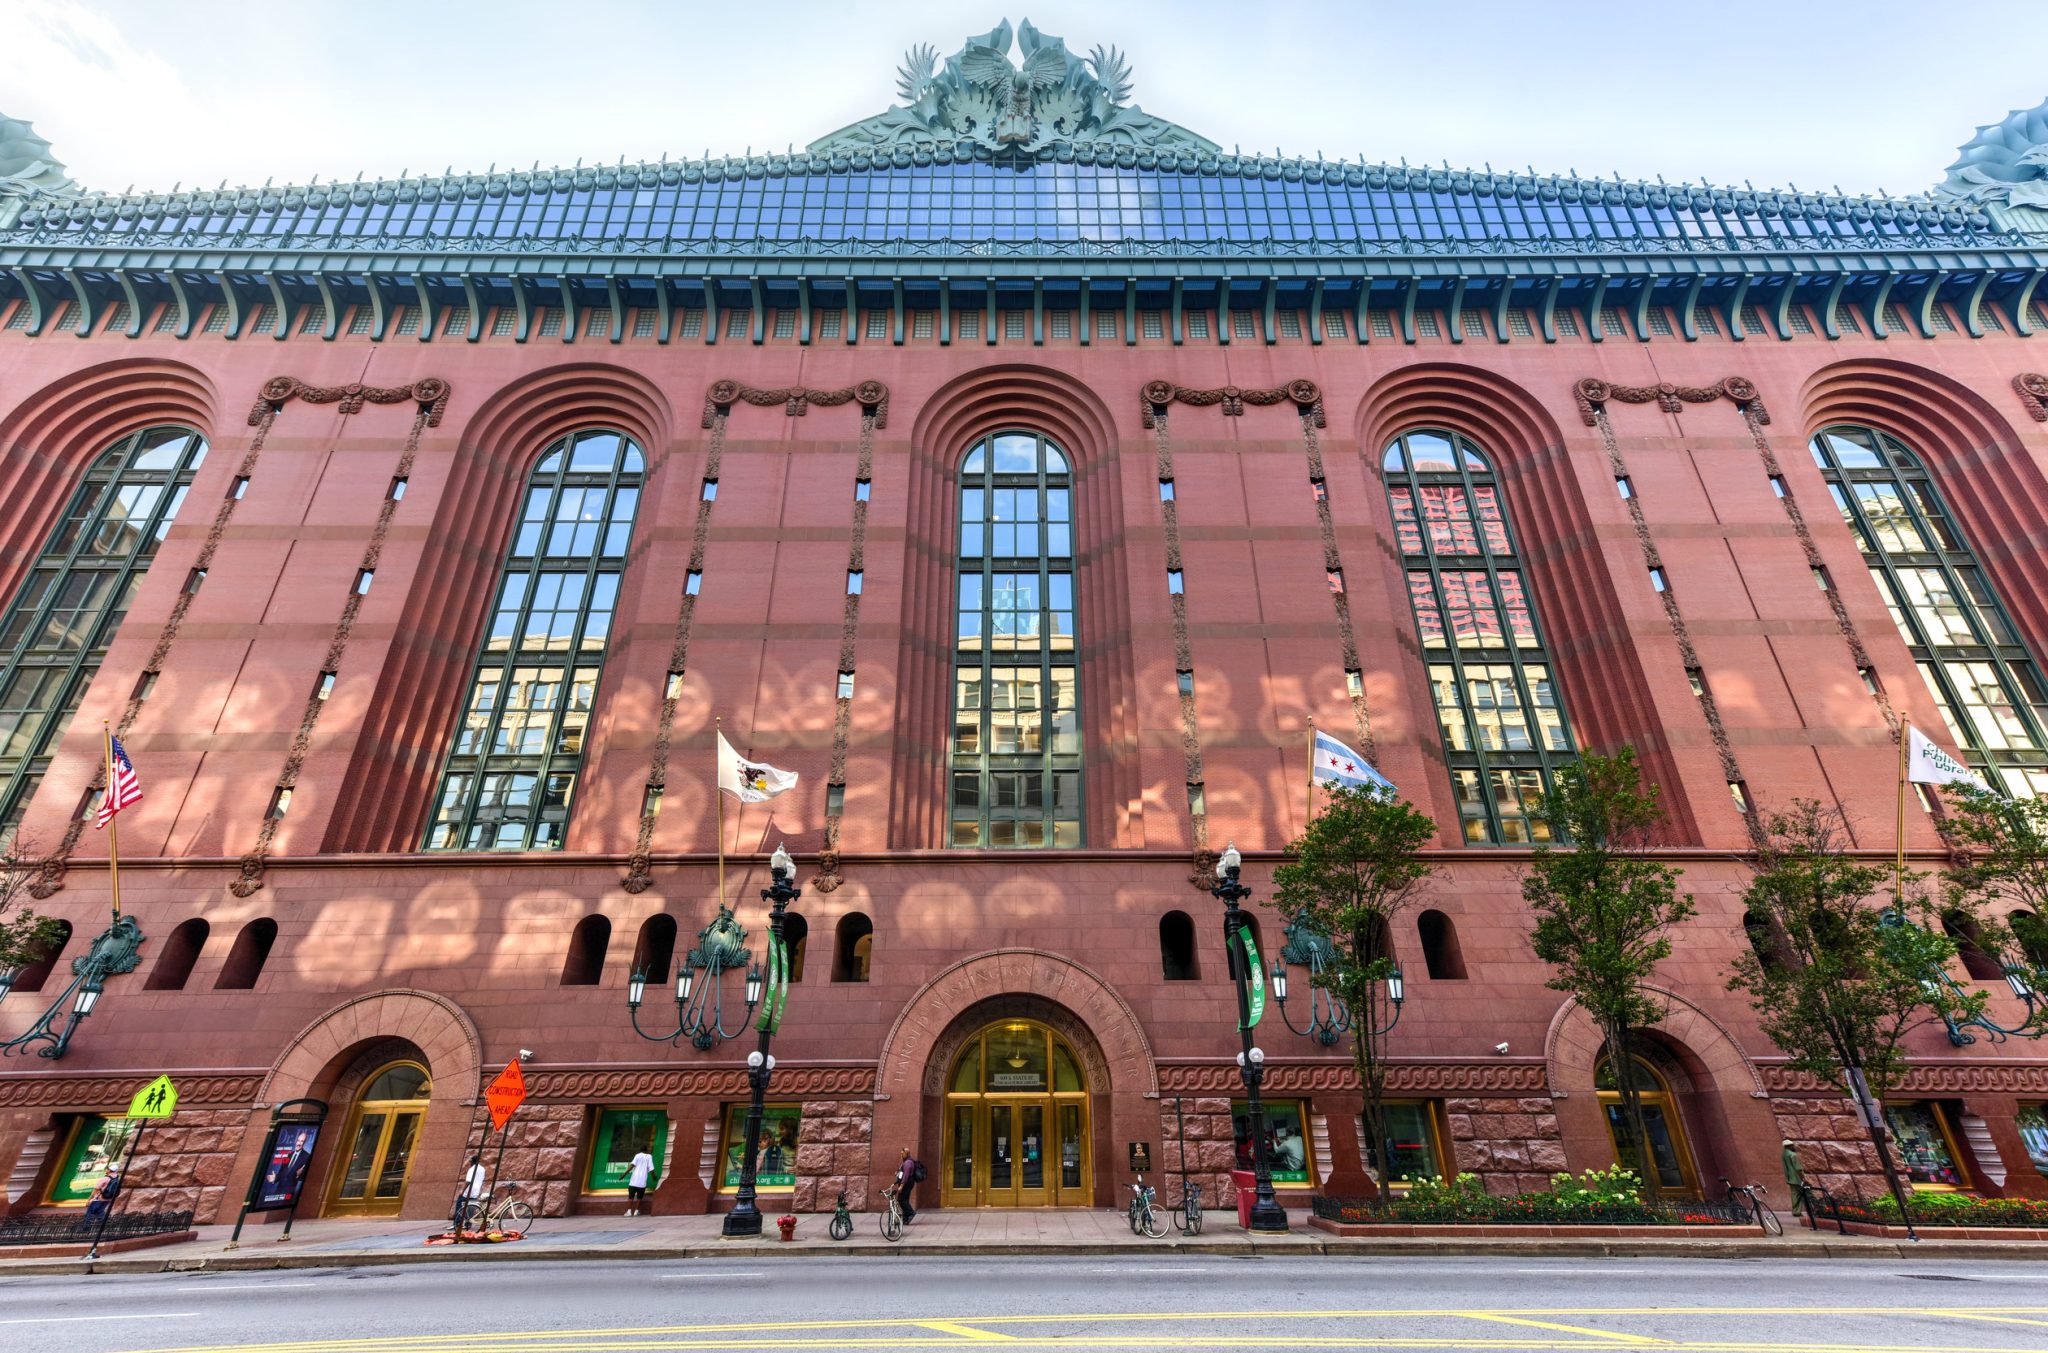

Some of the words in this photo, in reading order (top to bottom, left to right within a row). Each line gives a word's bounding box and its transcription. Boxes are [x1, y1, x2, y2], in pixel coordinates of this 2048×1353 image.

[894, 1013, 930, 1082] HAROLD
[931, 965, 1034, 1011] WASHINGTON
[1104, 1014, 1139, 1080] CENTER
[505, 1069, 519, 1080] ROAD
[488, 1086, 523, 1097] CONSTRUCTION
[494, 1105, 512, 1115] AHEAD
